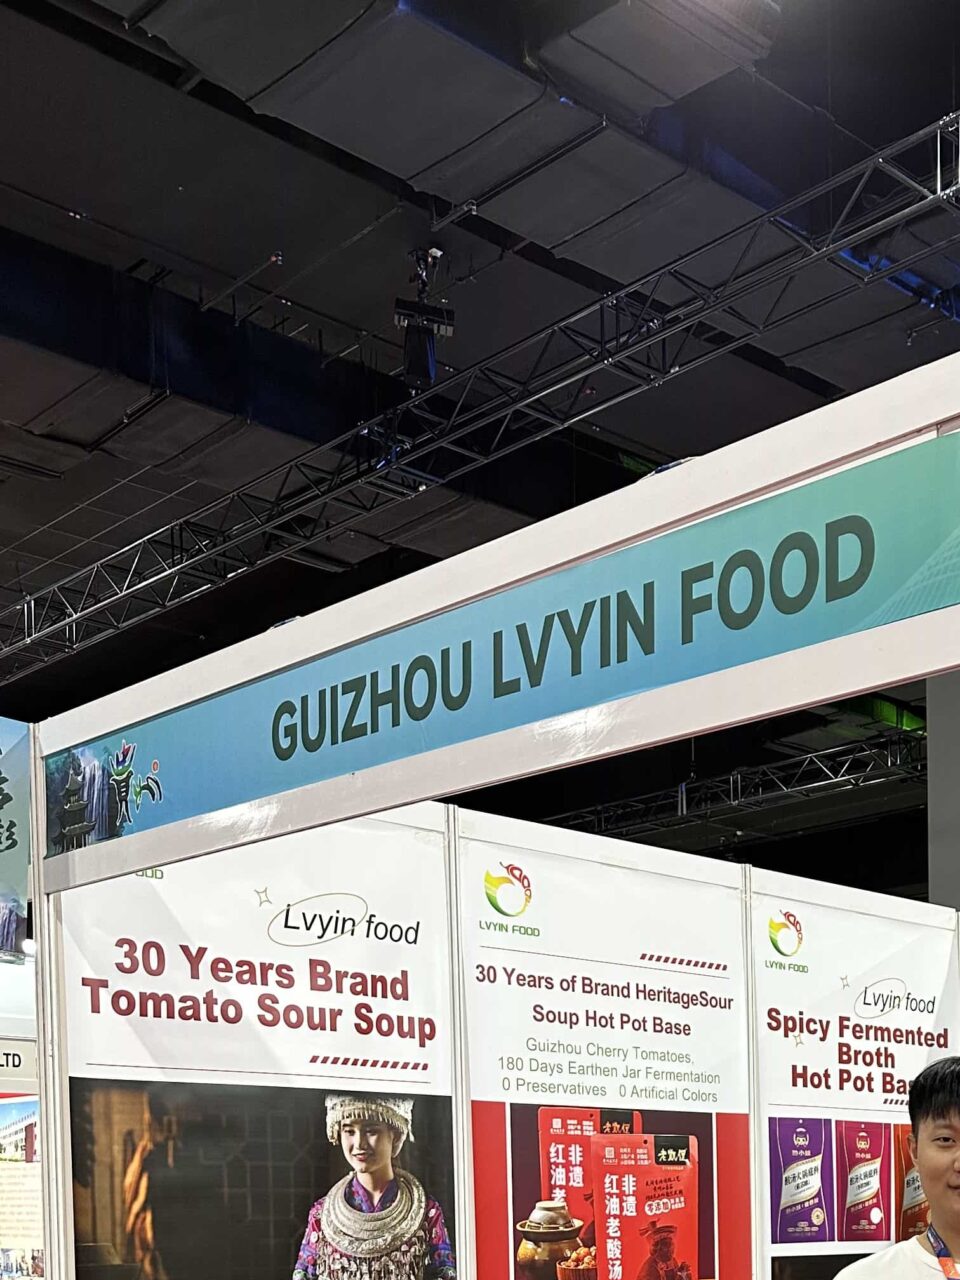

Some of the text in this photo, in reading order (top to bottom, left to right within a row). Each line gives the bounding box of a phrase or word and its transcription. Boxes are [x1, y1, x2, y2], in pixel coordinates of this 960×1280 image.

[271, 514, 876, 762] GUIZHOU LVYIN FOOD
[284, 903, 420, 944] Lvyin food
[479, 920, 540, 937] LVYIN FOOD
[114, 937, 408, 1001] 30 Years Brand
[765, 960, 808, 973] LVYIN FOOD
[475, 964, 733, 1010] 30 Years of Brand HeritageSour
[863, 986, 936, 1014] Lvyin food
[82, 977, 436, 1048] Tomato Sour Soup
[532, 1004, 691, 1036] Soup Hot Pot Base
[767, 1007, 949, 1049] Spicy Fermented
[526, 1037, 582, 1055] Guizhou
[586, 1042, 629, 1063] Cherry
[838, 1042, 895, 1069] Broth
[498, 1056, 721, 1084] 180 Days Earthen Jar Fermentation
[791, 1064, 913, 1095] Hot Pot Ba
[502, 1077, 718, 1103] 0 Preservatives 0 Artificial Colors
[568, 1144, 584, 1187] 非遗
[622, 1174, 637, 1216] 非遗
[603, 1173, 623, 1280] 红油老酸汤
